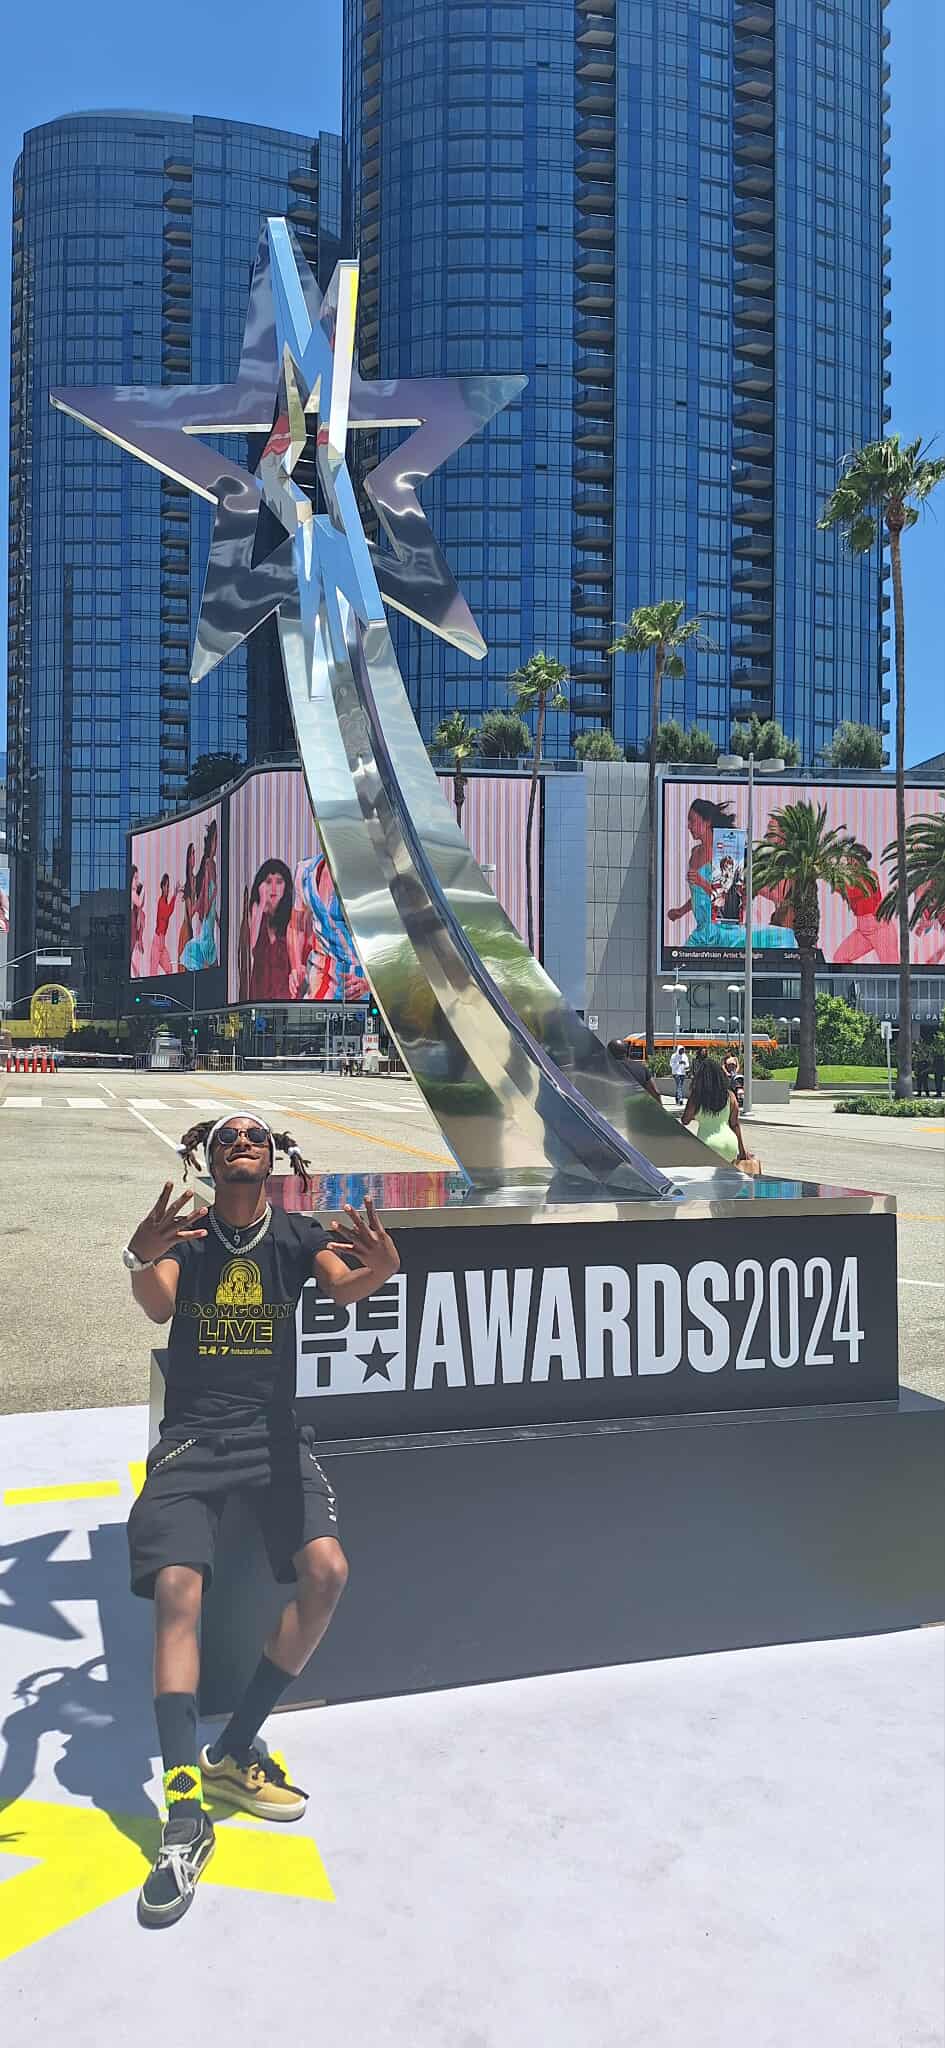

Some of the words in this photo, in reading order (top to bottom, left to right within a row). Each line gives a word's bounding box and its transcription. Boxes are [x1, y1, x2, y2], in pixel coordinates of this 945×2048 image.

[315, 1011, 355, 1021] CHASE
[885, 1013, 921, 1021] PUIC
[199, 1319, 273, 1343] LIVE
[413, 1260, 730, 1390] AWARDS
[734, 1256, 865, 1370] 2024
